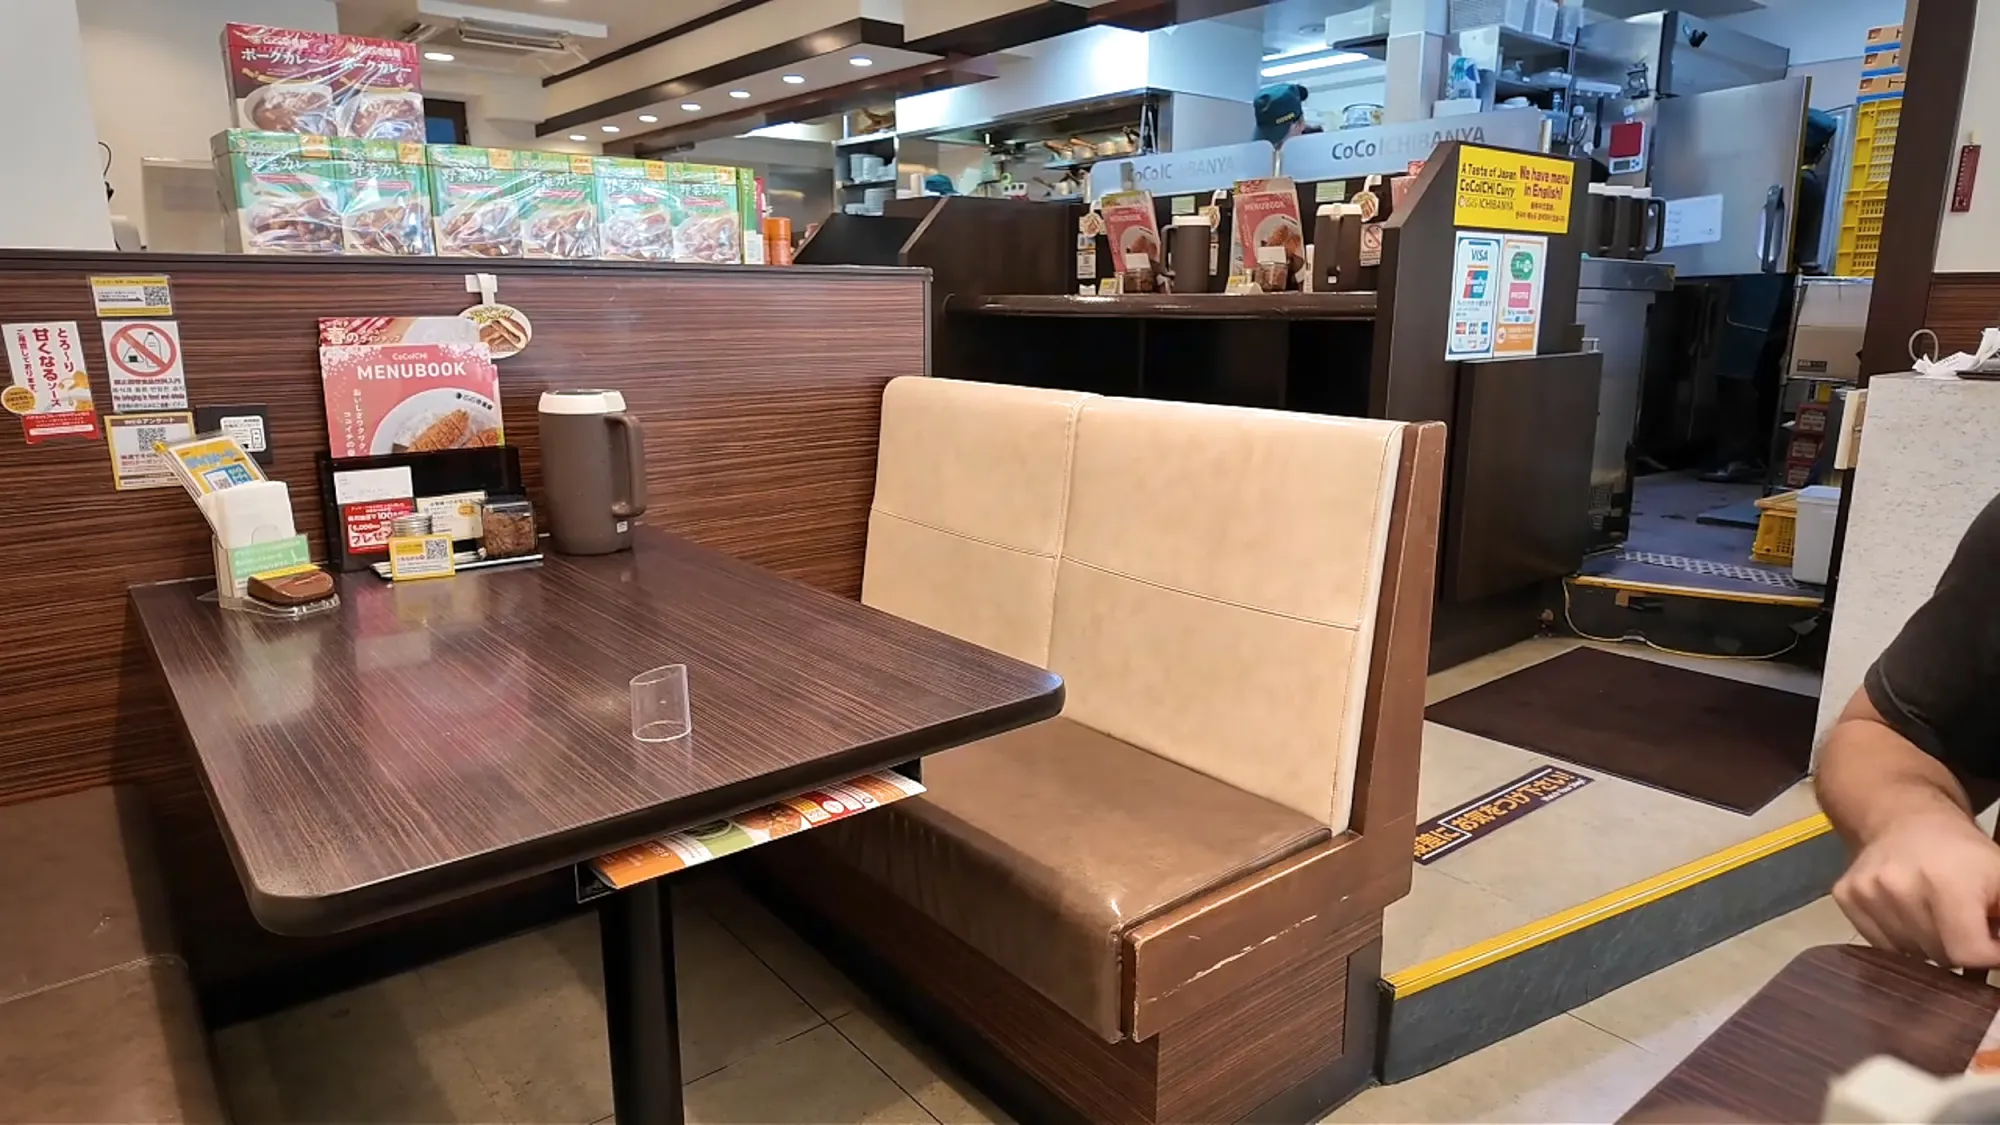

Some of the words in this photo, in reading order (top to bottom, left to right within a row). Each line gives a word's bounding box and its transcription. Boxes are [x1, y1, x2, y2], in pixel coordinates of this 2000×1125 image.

[241, 47, 321, 64] ポークカレー
[1461, 162, 1467, 174] A
[1468, 163, 1487, 177] Taste
[1489, 166, 1497, 177] of
[1497, 168, 1517, 180] Japan
[1520, 165, 1530, 180] We
[1531, 167, 1549, 182] have
[1550, 171, 1570, 185] menu
[1496, 182, 1515, 198] Curry
[1523, 183, 1531, 197] in
[1532, 183, 1563, 200] English!
[1471, 248, 1489, 261] VISA
[32, 327, 62, 407] 甘くなるソース
[357, 361, 467, 381] MENUBOOK
